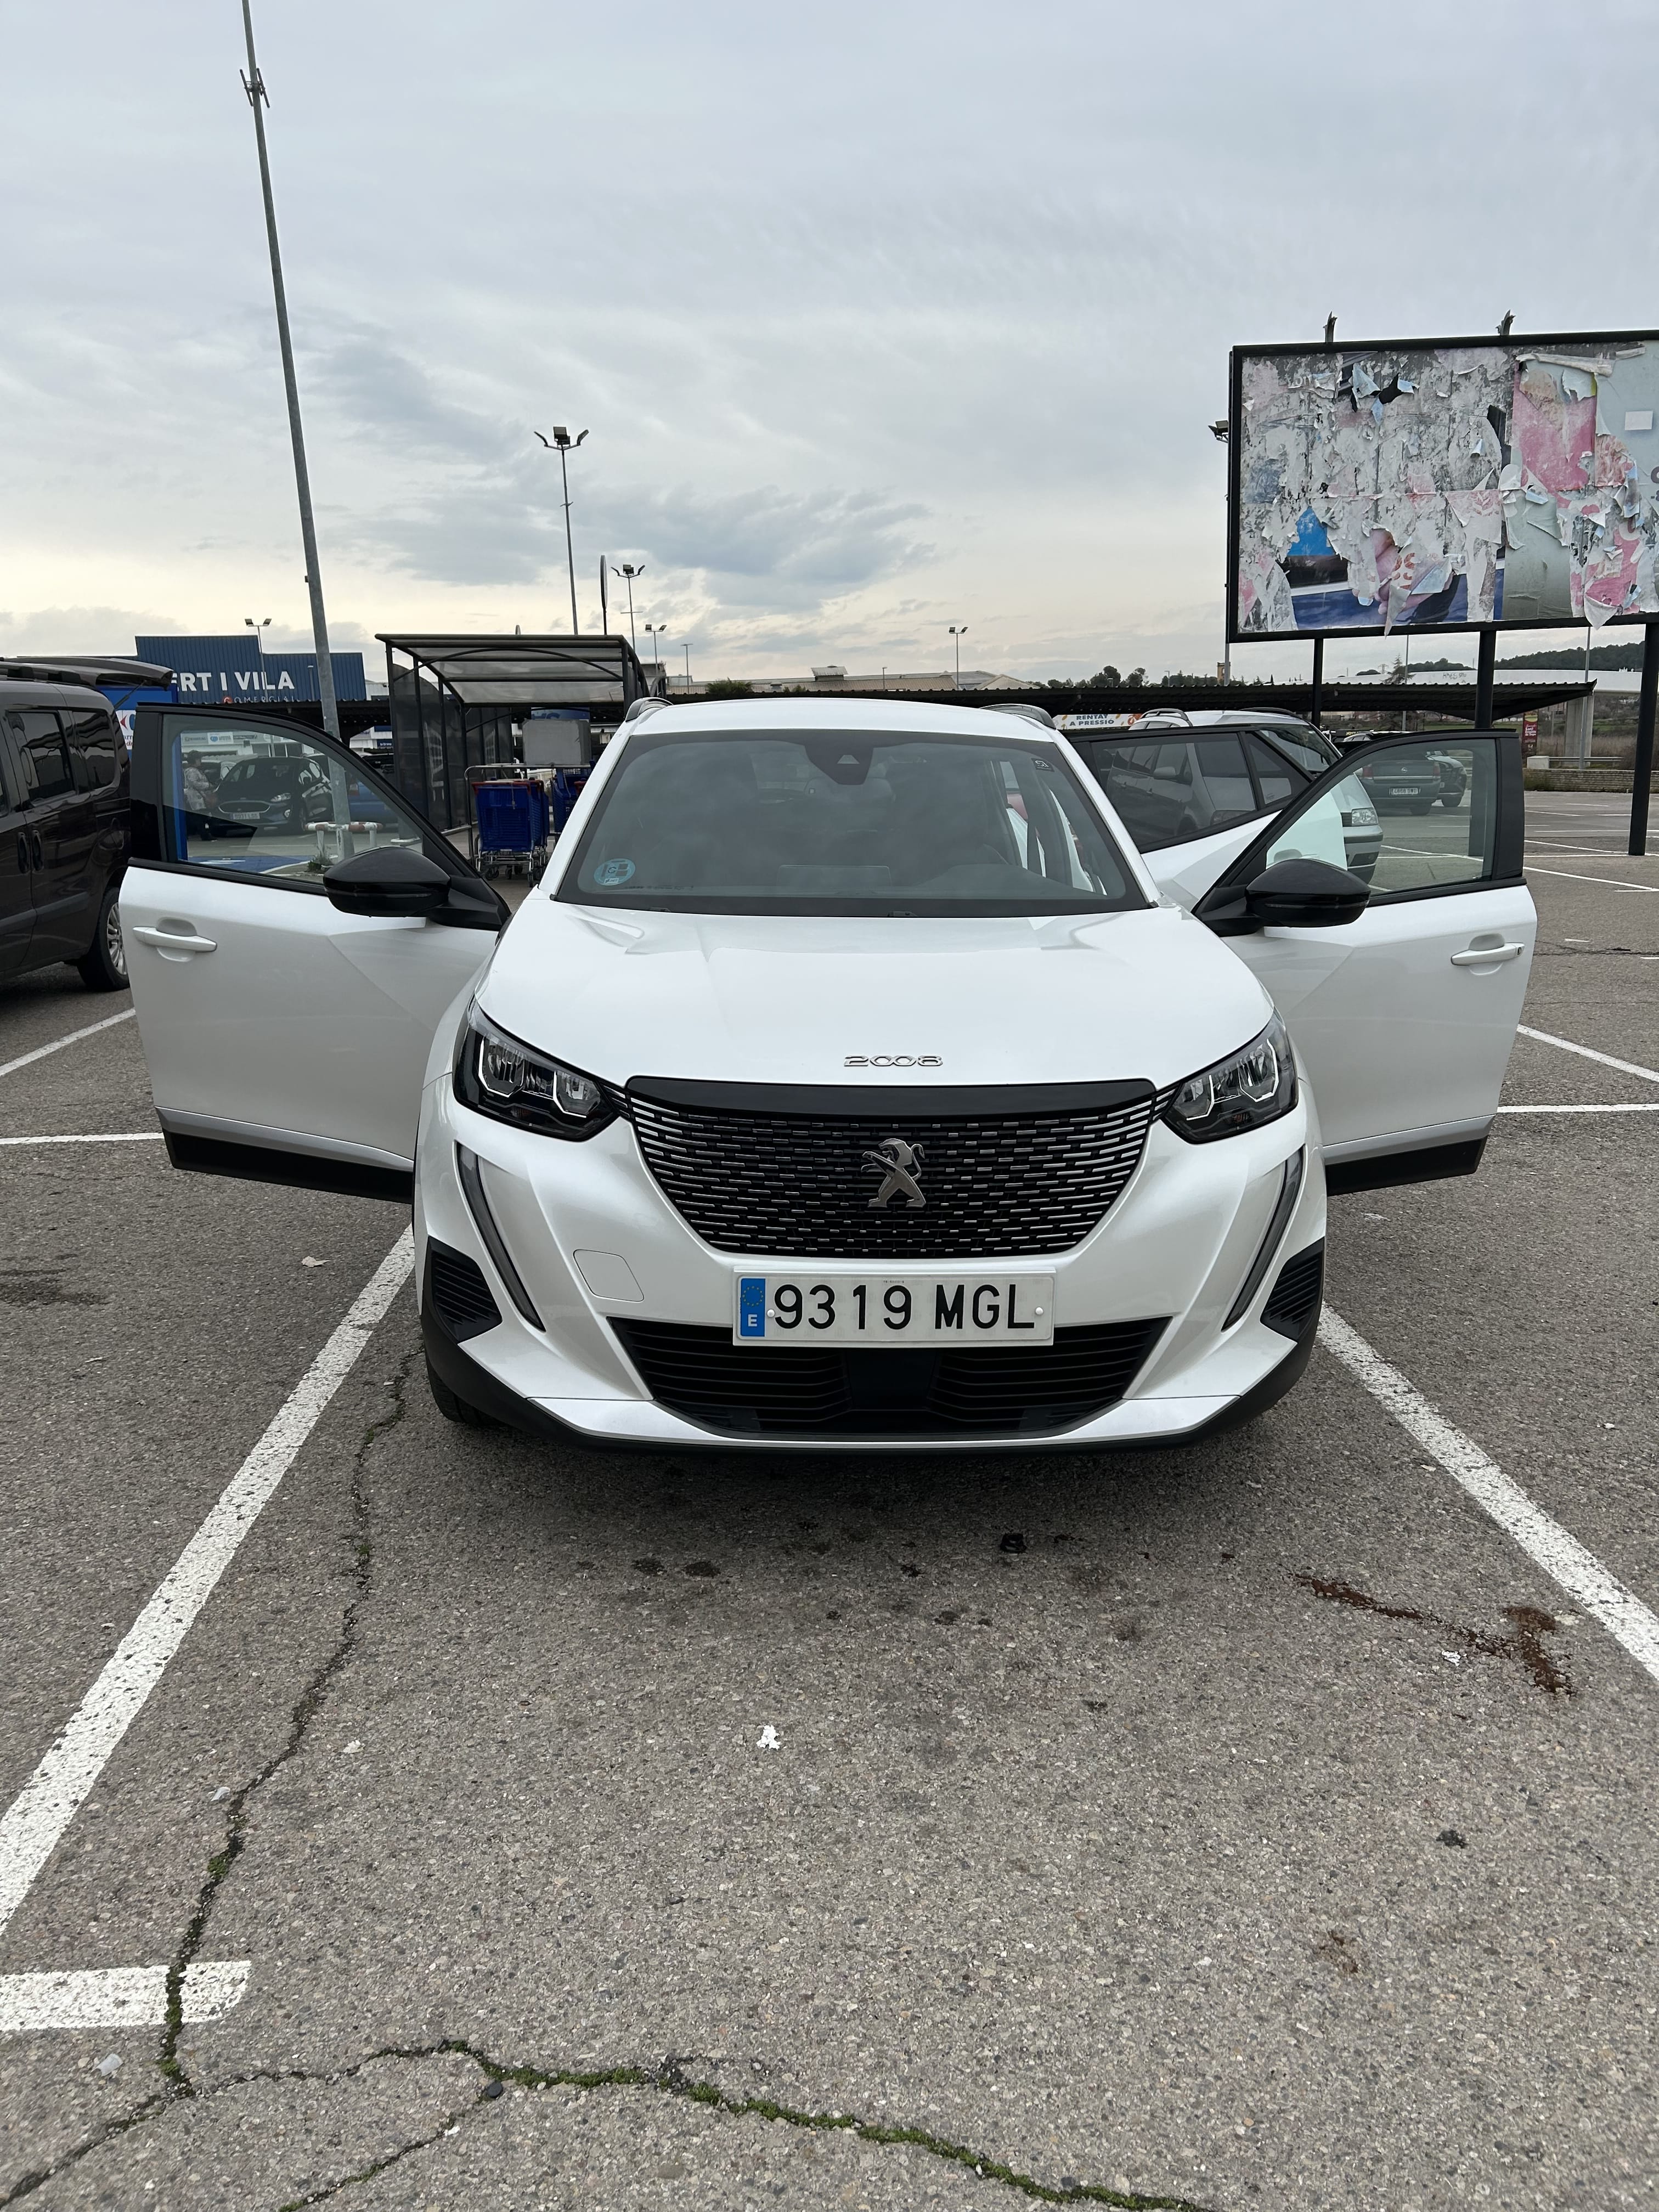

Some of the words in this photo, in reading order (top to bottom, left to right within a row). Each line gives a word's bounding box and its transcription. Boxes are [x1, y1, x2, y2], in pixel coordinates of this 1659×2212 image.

[221, 672, 228, 691] I
[234, 671, 295, 690] VILA
[843, 1055, 944, 1067] 2008
[747, 1314, 757, 1327] E
[774, 1284, 912, 1330] 9319
[935, 1284, 1035, 1330] MGL
